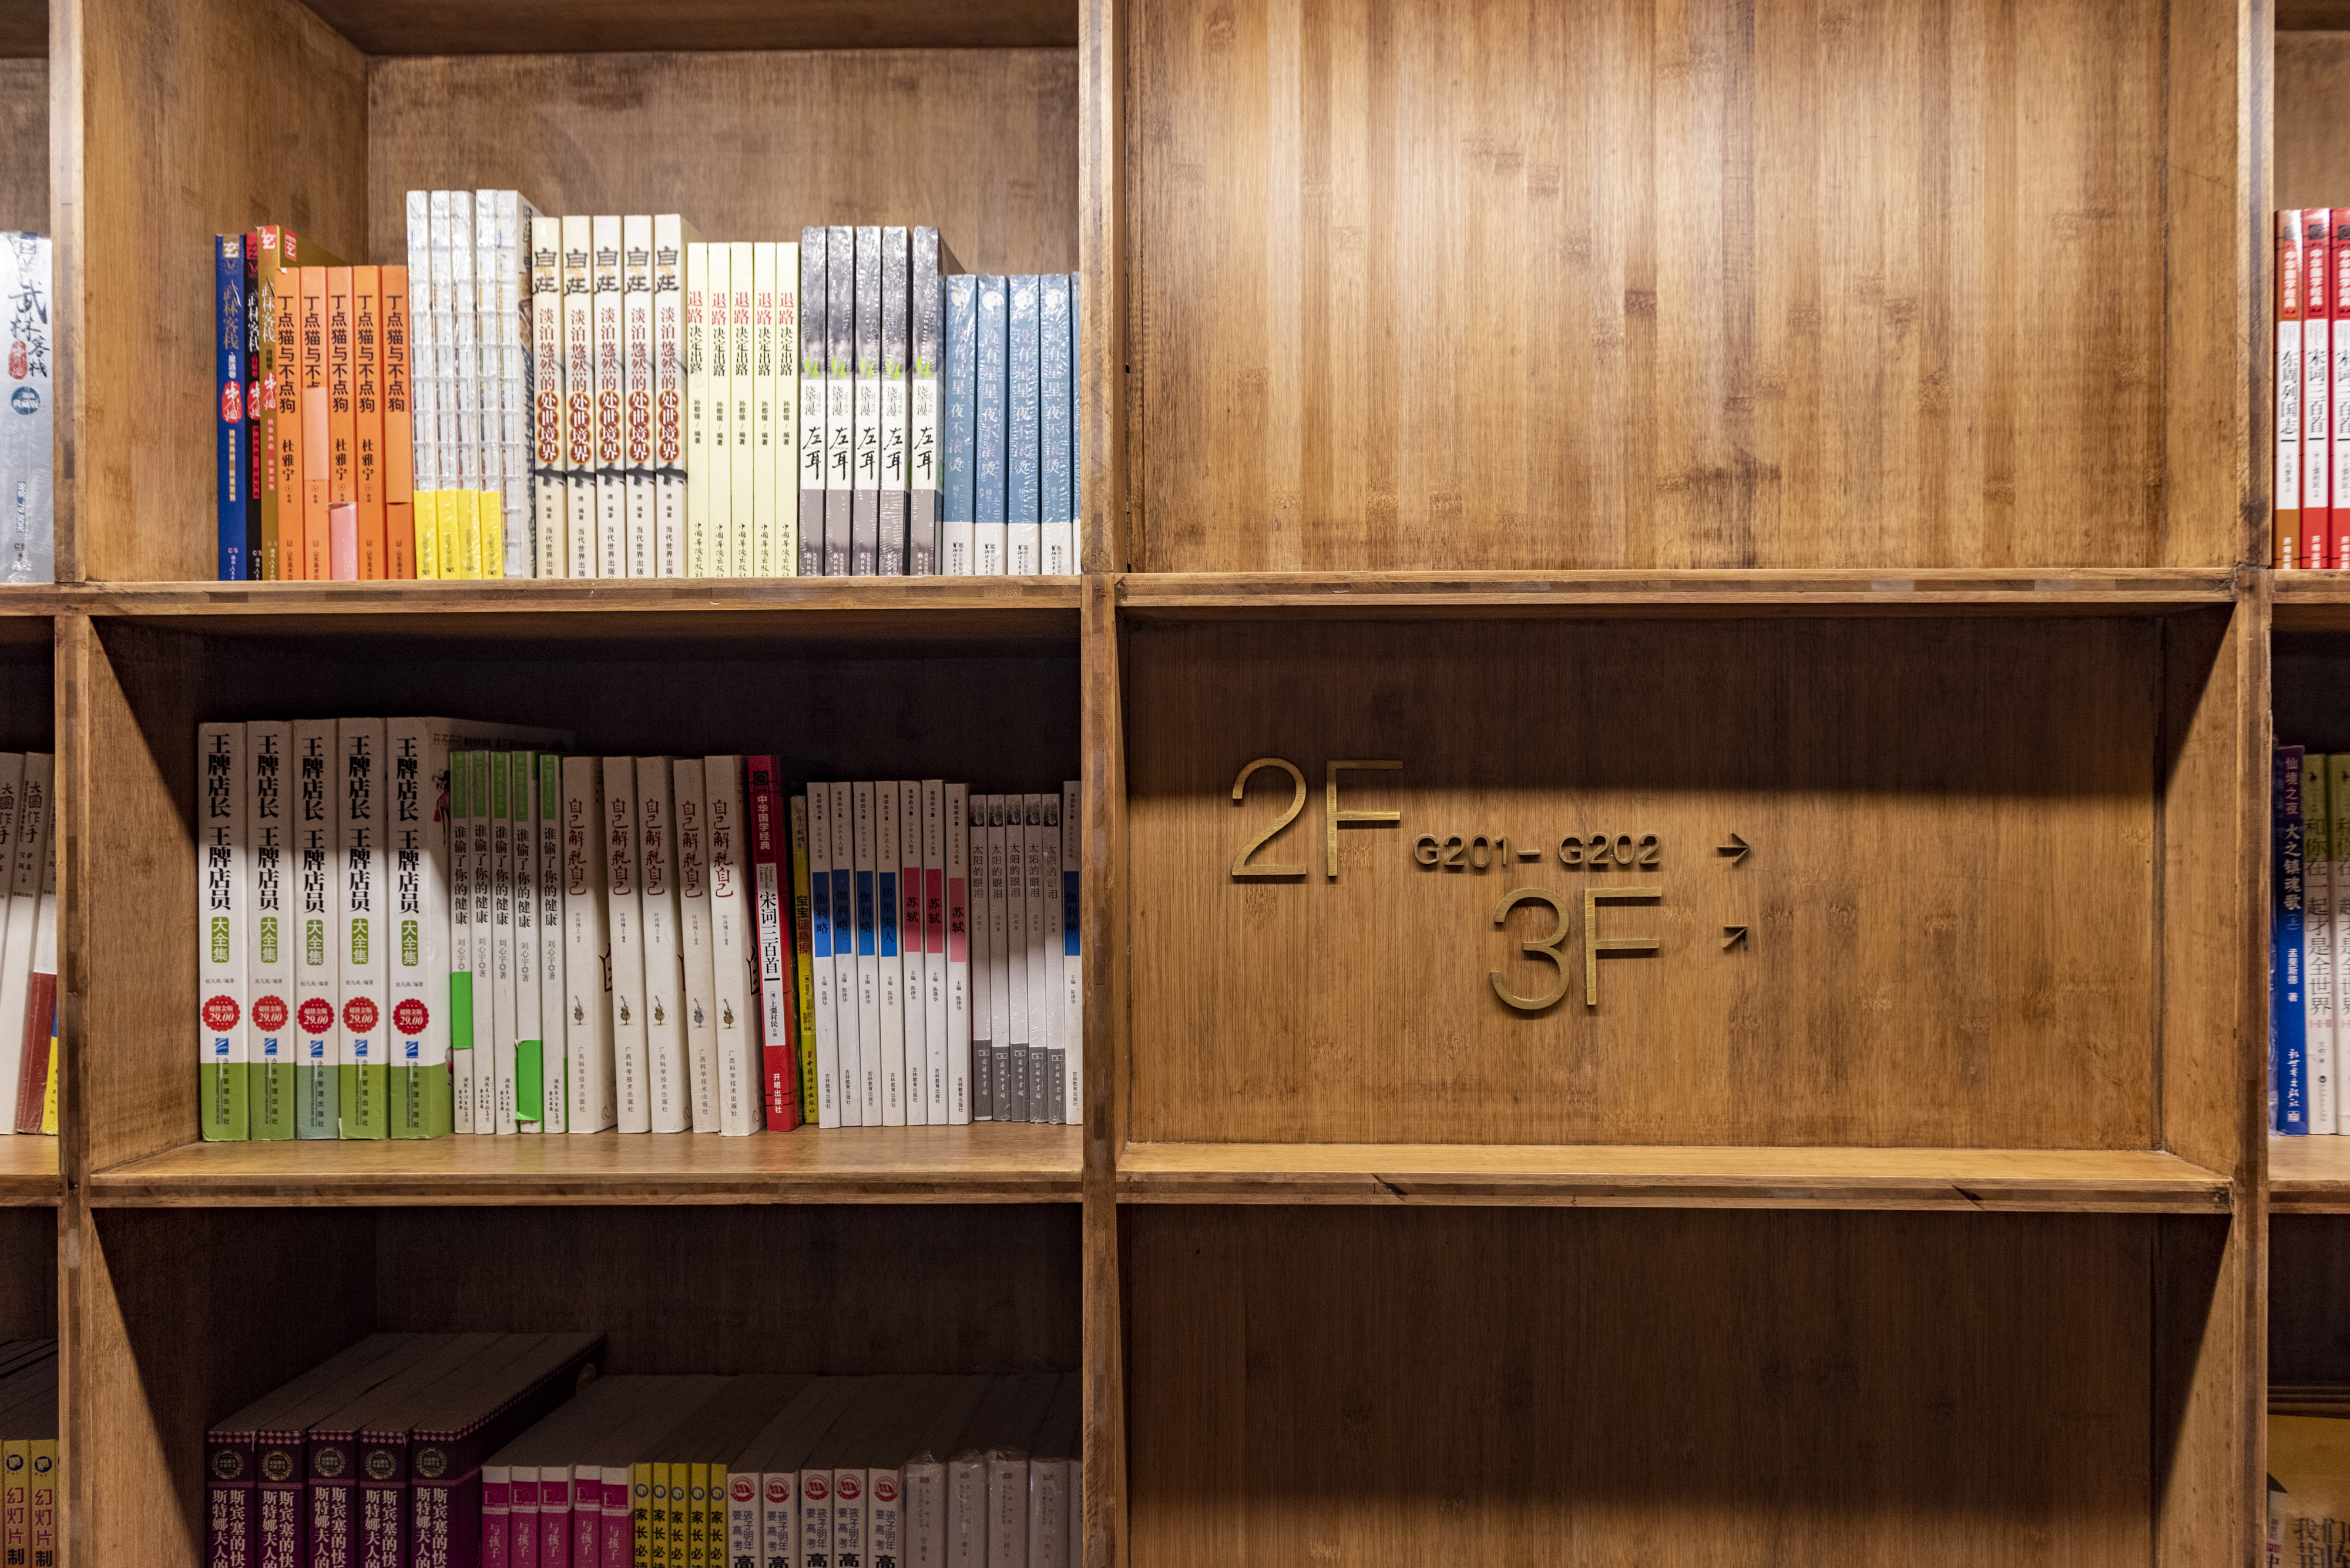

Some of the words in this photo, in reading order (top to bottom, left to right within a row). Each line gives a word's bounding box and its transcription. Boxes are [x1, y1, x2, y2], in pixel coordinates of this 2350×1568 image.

[277, 296, 295, 413] 丁点猫与不点狗
[330, 295, 348, 412] 丁点猫与不点狗
[357, 295, 375, 412] 丁点猫与不点狗
[386, 295, 404, 412] 丁点猫与不点狗
[688, 291, 703, 375] 退路决定出路
[711, 293, 726, 377] 退路决定出路
[734, 292, 749, 376] 退路决定出路
[757, 293, 771, 377] 退路决定出路
[779, 293, 794, 376] 退路决定出路
[282, 439, 294, 481] 杜雅宁
[335, 439, 347, 480] 杜雅宁
[362, 439, 374, 481] 杜雅宁
[803, 427, 822, 481] 左耳
[829, 427, 849, 481] 左耳
[857, 427, 877, 481] 左耳
[883, 428, 903, 481] 左耳
[914, 427, 934, 481] 左耳
[208, 734, 231, 818] 王牌店长
[257, 734, 279, 818] 王牌店长
[302, 737, 324, 821] 王牌店长
[349, 735, 370, 820] 王牌店长
[397, 737, 418, 821] 王牌店长
[757, 795, 770, 850] 中华国学经典
[1231, 757, 1404, 877] 2F
[1557, 832, 1661, 865] G202
[209, 825, 231, 911] 王牌店员
[257, 826, 280, 911] 王牌店员
[303, 828, 325, 914] 王牌店员
[349, 827, 370, 912] 王牌店员
[398, 829, 419, 914] 王牌店员
[455, 826, 467, 925] 谁偷了你的健康
[475, 824, 488, 923] 谁偷了你的健康
[495, 826, 509, 925] 谁偷了你的健康
[517, 829, 531, 928] 谁偷了你的健康
[544, 827, 557, 926] 谁偷了你的健康
[973, 845, 983, 899] 太阳的眼泪
[992, 845, 1003, 899] 太阳的眼泪
[1010, 843, 1020, 898] 太阳的眼泪
[1029, 843, 1040, 898] 太阳的眼泪
[1046, 845, 1058, 899] 太阳的眼泪
[760, 892, 780, 974] 宋词三百首
[797, 895, 810, 954] 宝宝健身操
[815, 893, 829, 934] 伽利略
[837, 890, 848, 931] 伽利略
[860, 892, 871, 932] 伽利略
[882, 887, 894, 943] 居里夫人
[907, 897, 918, 923] 苏轼
[928, 898, 940, 924] 苏轼
[952, 907, 964, 933] 苏轼
[1066, 892, 1078, 933] 伽利略
[213, 918, 228, 962] 大全集
[261, 918, 276, 961] 大全集
[308, 921, 323, 965] 大全集
[352, 919, 368, 963] 大全集
[402, 922, 417, 965] 大全集
[1490, 887, 1662, 1010] 3F
[209, 1013, 234, 1023] 29.00
[258, 1013, 282, 1023] 29.00
[304, 1016, 328, 1025] 29.00
[348, 1015, 372, 1024] 29.00
[400, 1016, 423, 1026] 29.00
[625, 1046, 634, 1112] 广西科学技术出版社
[659, 1046, 668, 1112] 广西科学技术出版社
[699, 1049, 709, 1114] 广西科学技术出版社
[728, 1050, 738, 1117] 广西科学技术出版社
[773, 1073, 782, 1113] 开明出版社
[230, 1490, 246, 1568] 斯宾塞的快
[279, 1491, 294, 1568] 斯宾塞的快
[331, 1487, 347, 1568] 斯宾塞的快
[382, 1490, 397, 1568] 斯宾塞的快
[432, 1488, 448, 1568] 斯宾塞的快
[733, 1511, 743, 1550] 要高考
[743, 1510, 754, 1551] 孩子明年
[806, 1509, 816, 1549] 要高考
[817, 1508, 827, 1549] 孩子明年
[838, 1508, 848, 1549] 要高考
[849, 1508, 859, 1549] 孩子明年
